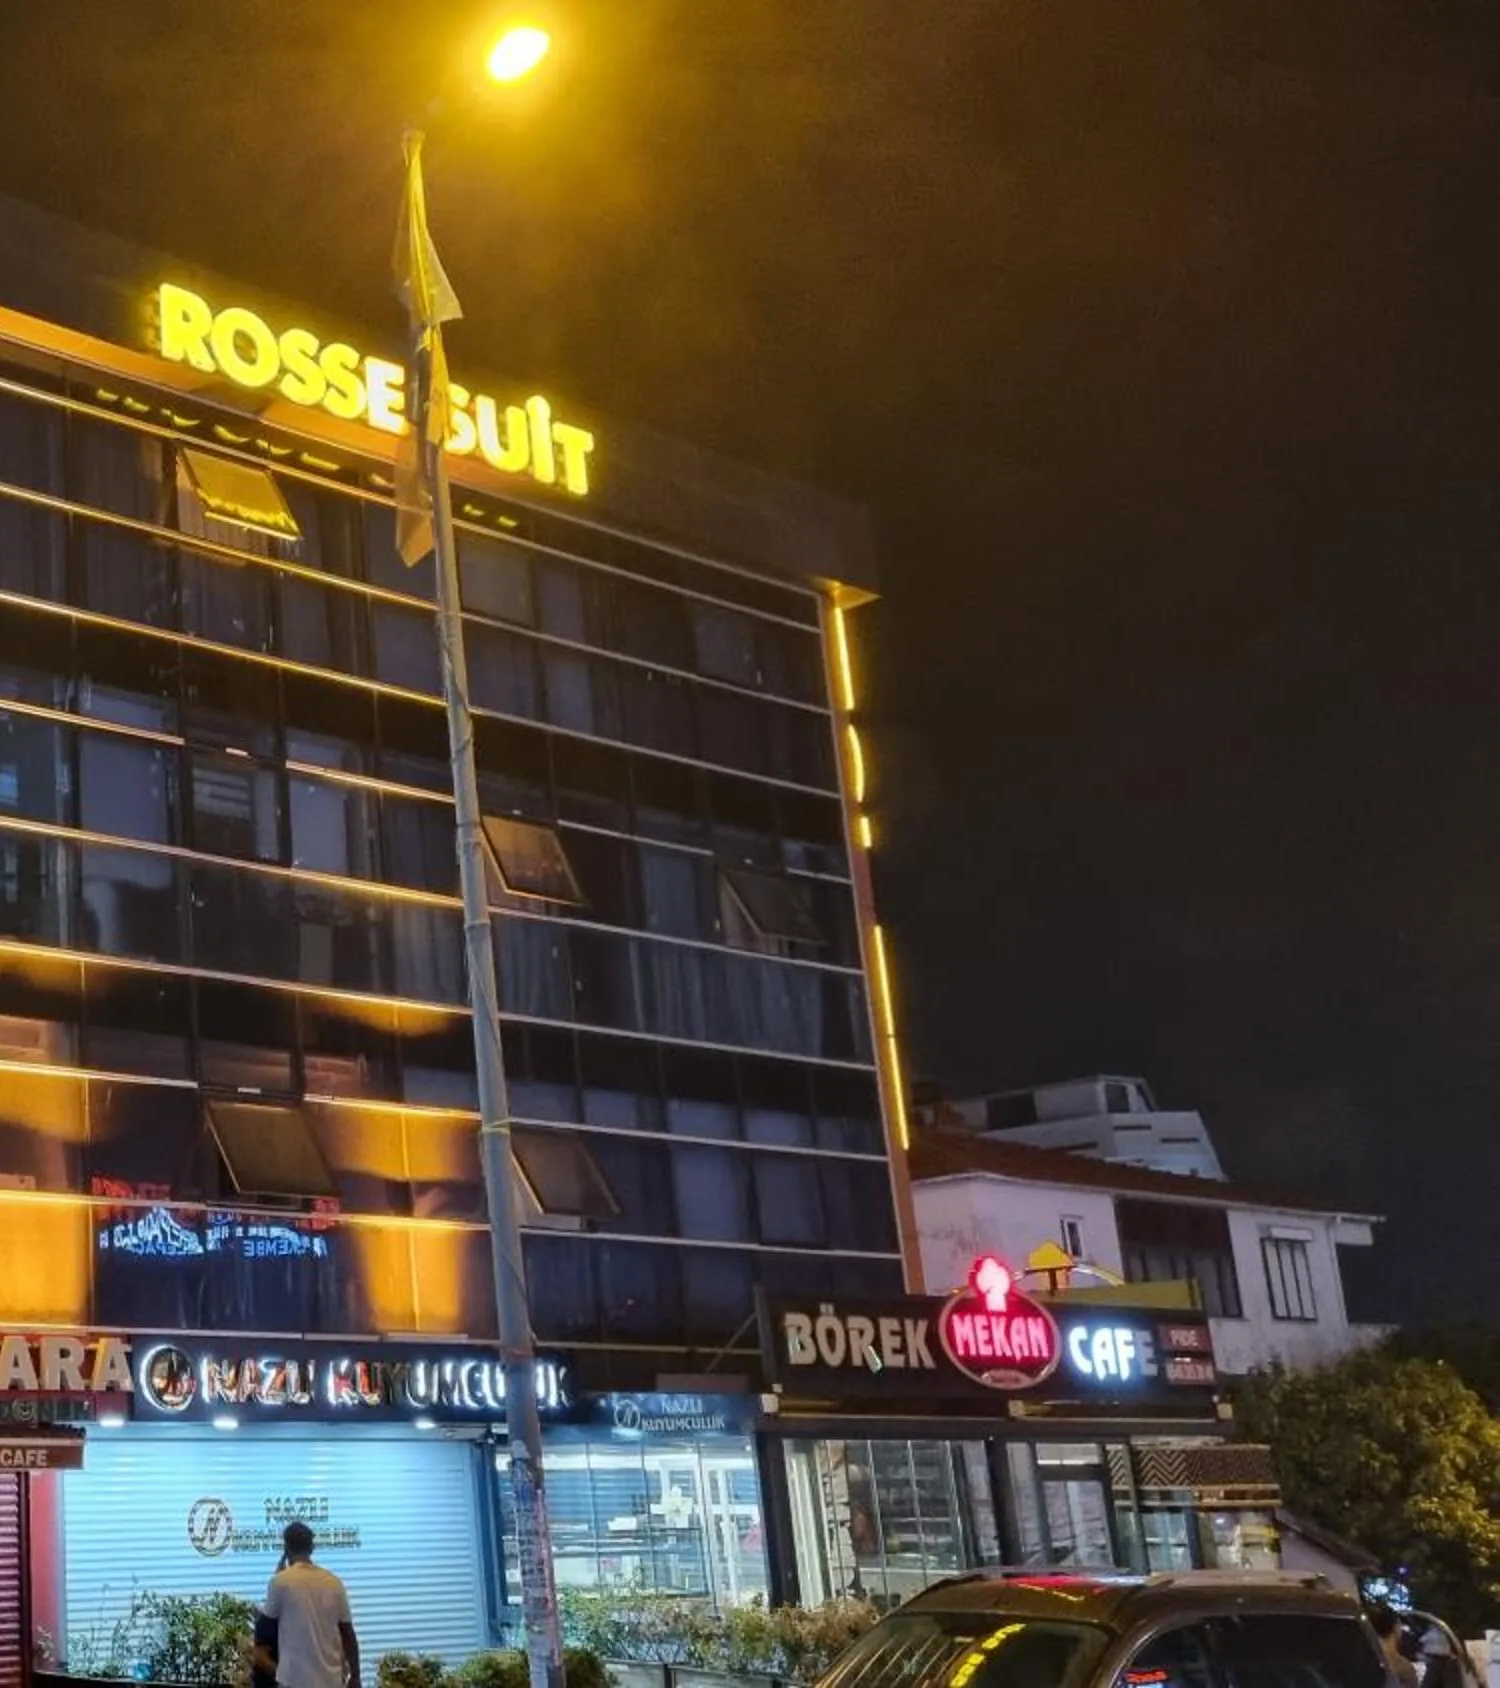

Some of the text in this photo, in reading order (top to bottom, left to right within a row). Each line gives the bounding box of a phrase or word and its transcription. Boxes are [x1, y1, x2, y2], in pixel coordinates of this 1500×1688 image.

[159, 283, 411, 436] ROSSE
[784, 1303, 1158, 1381] BÖREK MEKAN CAFE
[199, 1356, 572, 1409] NAZLI KUYUMCUUK
[0, 1449, 49, 1467] CAFE
